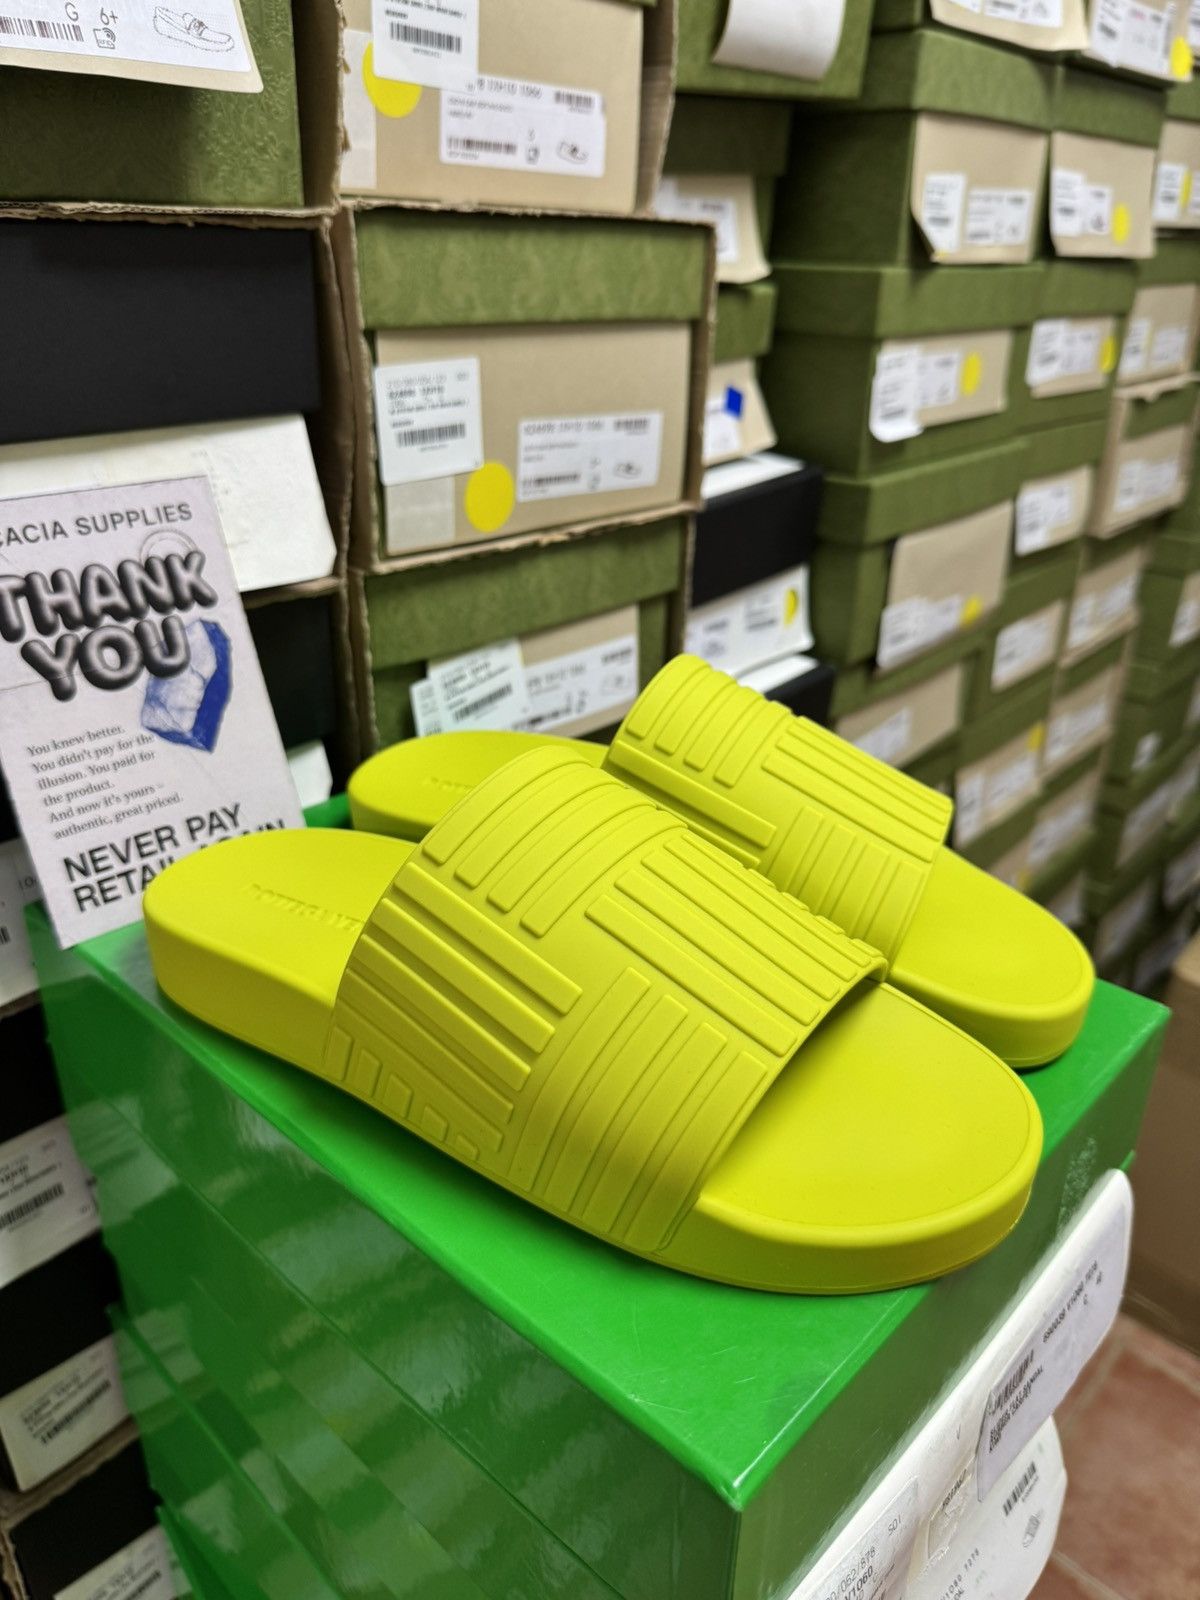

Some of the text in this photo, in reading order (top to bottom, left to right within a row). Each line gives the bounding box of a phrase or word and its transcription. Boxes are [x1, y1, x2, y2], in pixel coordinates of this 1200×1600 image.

[64, 2, 79, 22] G
[100, 7, 119, 26] 6+
[0, 503, 193, 547] ACIA SUPPLIES
[0, 550, 219, 643] THANK
[20, 615, 191, 702] YOU
[27, 726, 125, 757] You knew better.
[32, 760, 56, 774] You
[94, 744, 115, 760] pay
[117, 739, 134, 750] for
[136, 733, 156, 744] the
[38, 750, 156, 791] illusion. You paid for
[43, 779, 115, 807] the product.
[49, 806, 75, 824] And
[77, 801, 102, 816] now
[123, 784, 156, 804] yours
[54, 791, 183, 840] authentic, great priced.
[63, 824, 180, 882] NEVER
[185, 803, 241, 842] PAY
[73, 855, 174, 913] RETA
